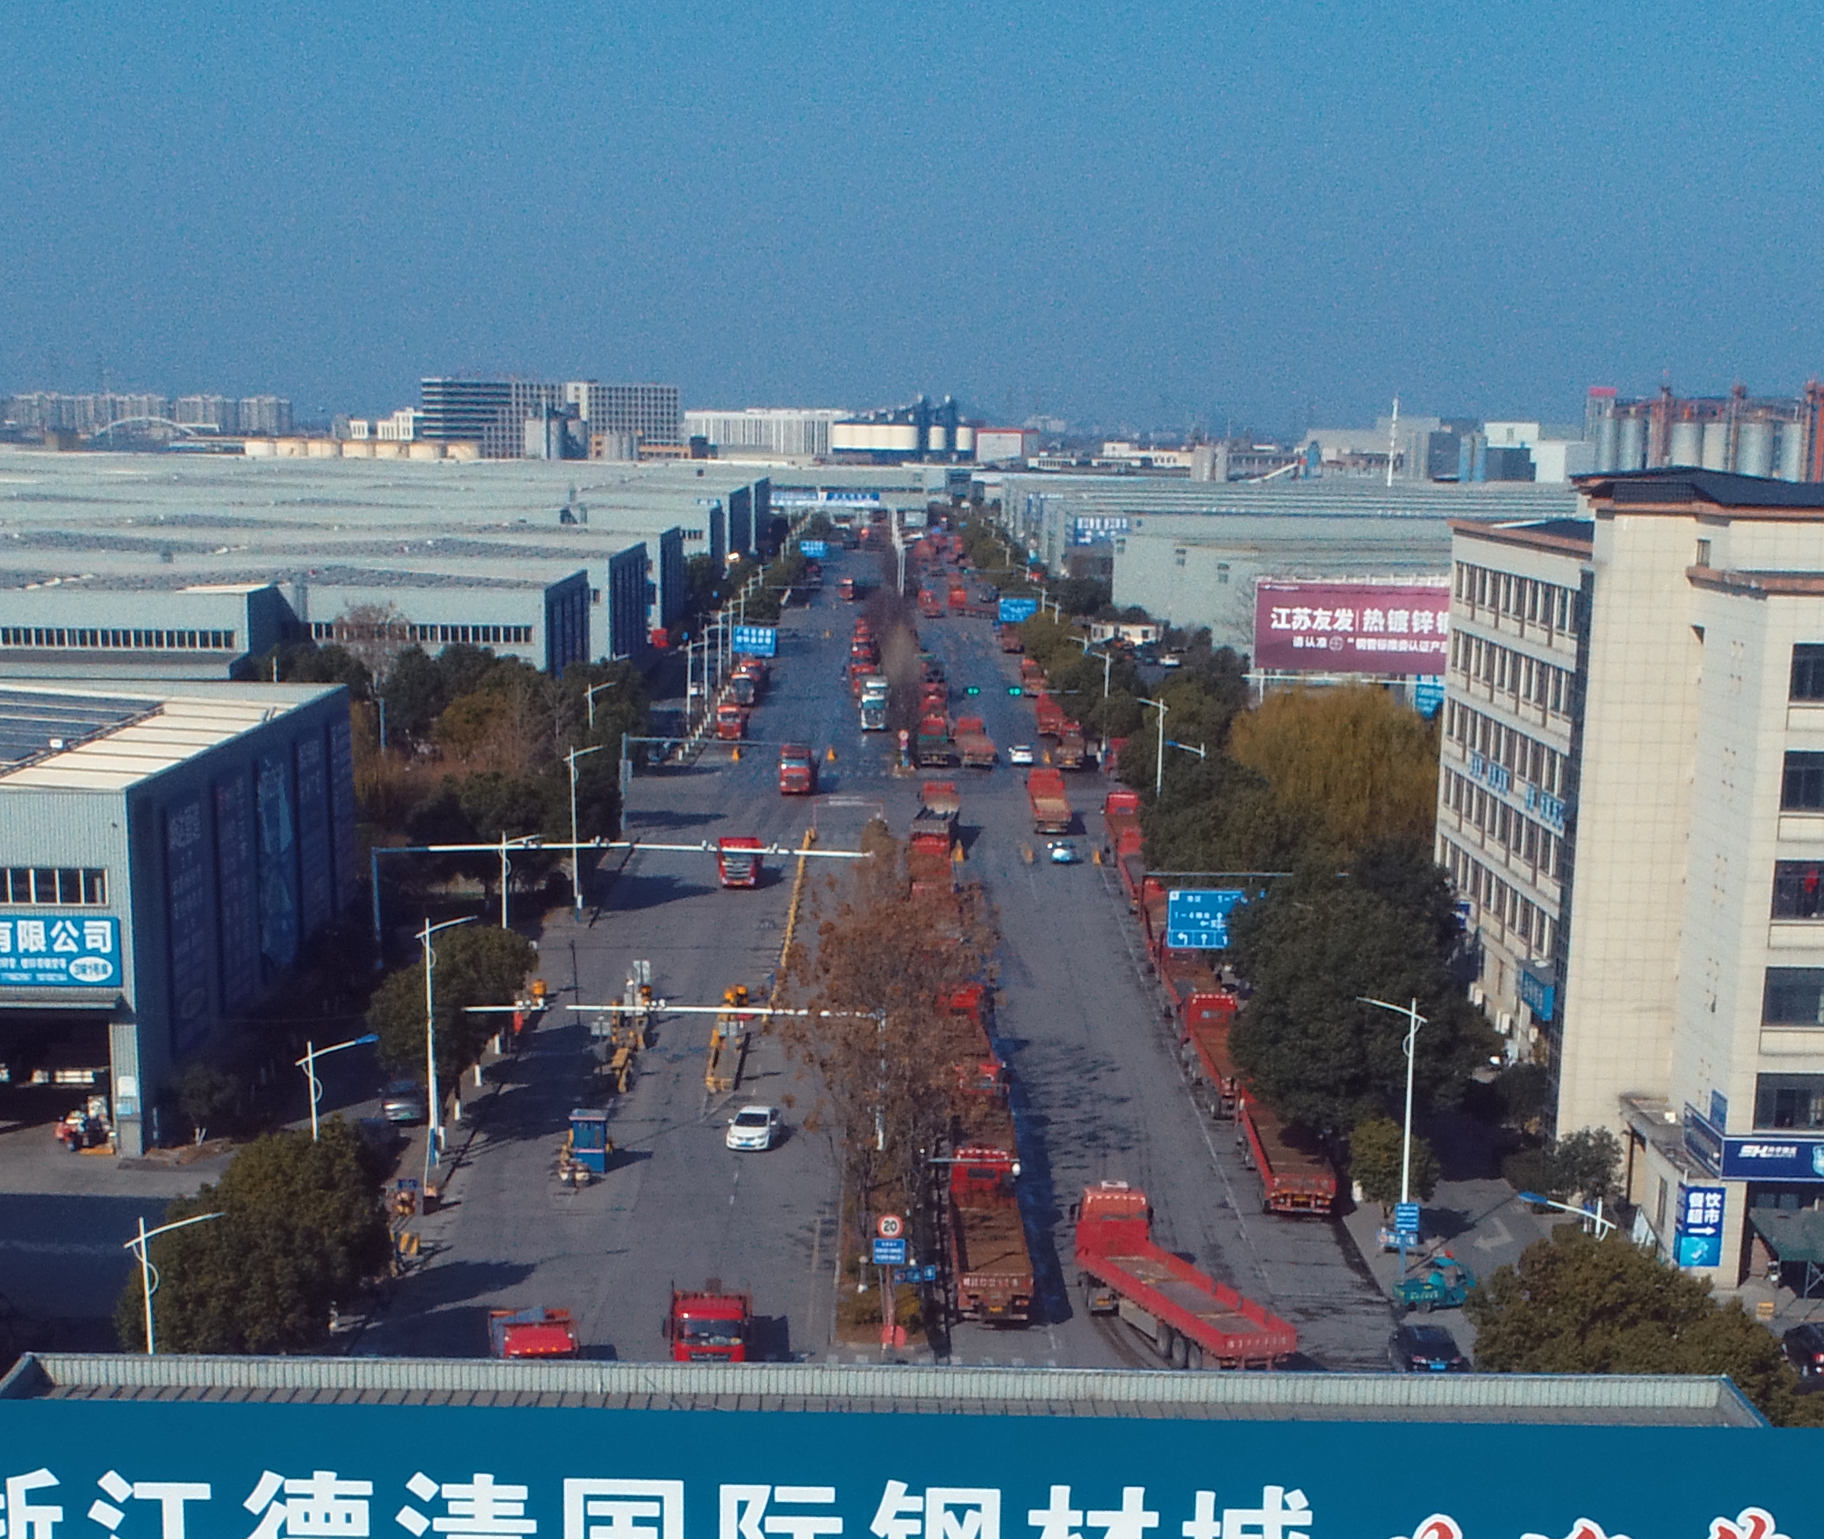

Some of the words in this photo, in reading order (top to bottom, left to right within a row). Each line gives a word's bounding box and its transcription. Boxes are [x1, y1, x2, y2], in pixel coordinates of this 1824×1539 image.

[1270, 606, 1354, 632] 江苏友发
[1688, 1192, 1722, 1209] 餐饮
[1686, 1208, 1720, 1224] 超市
